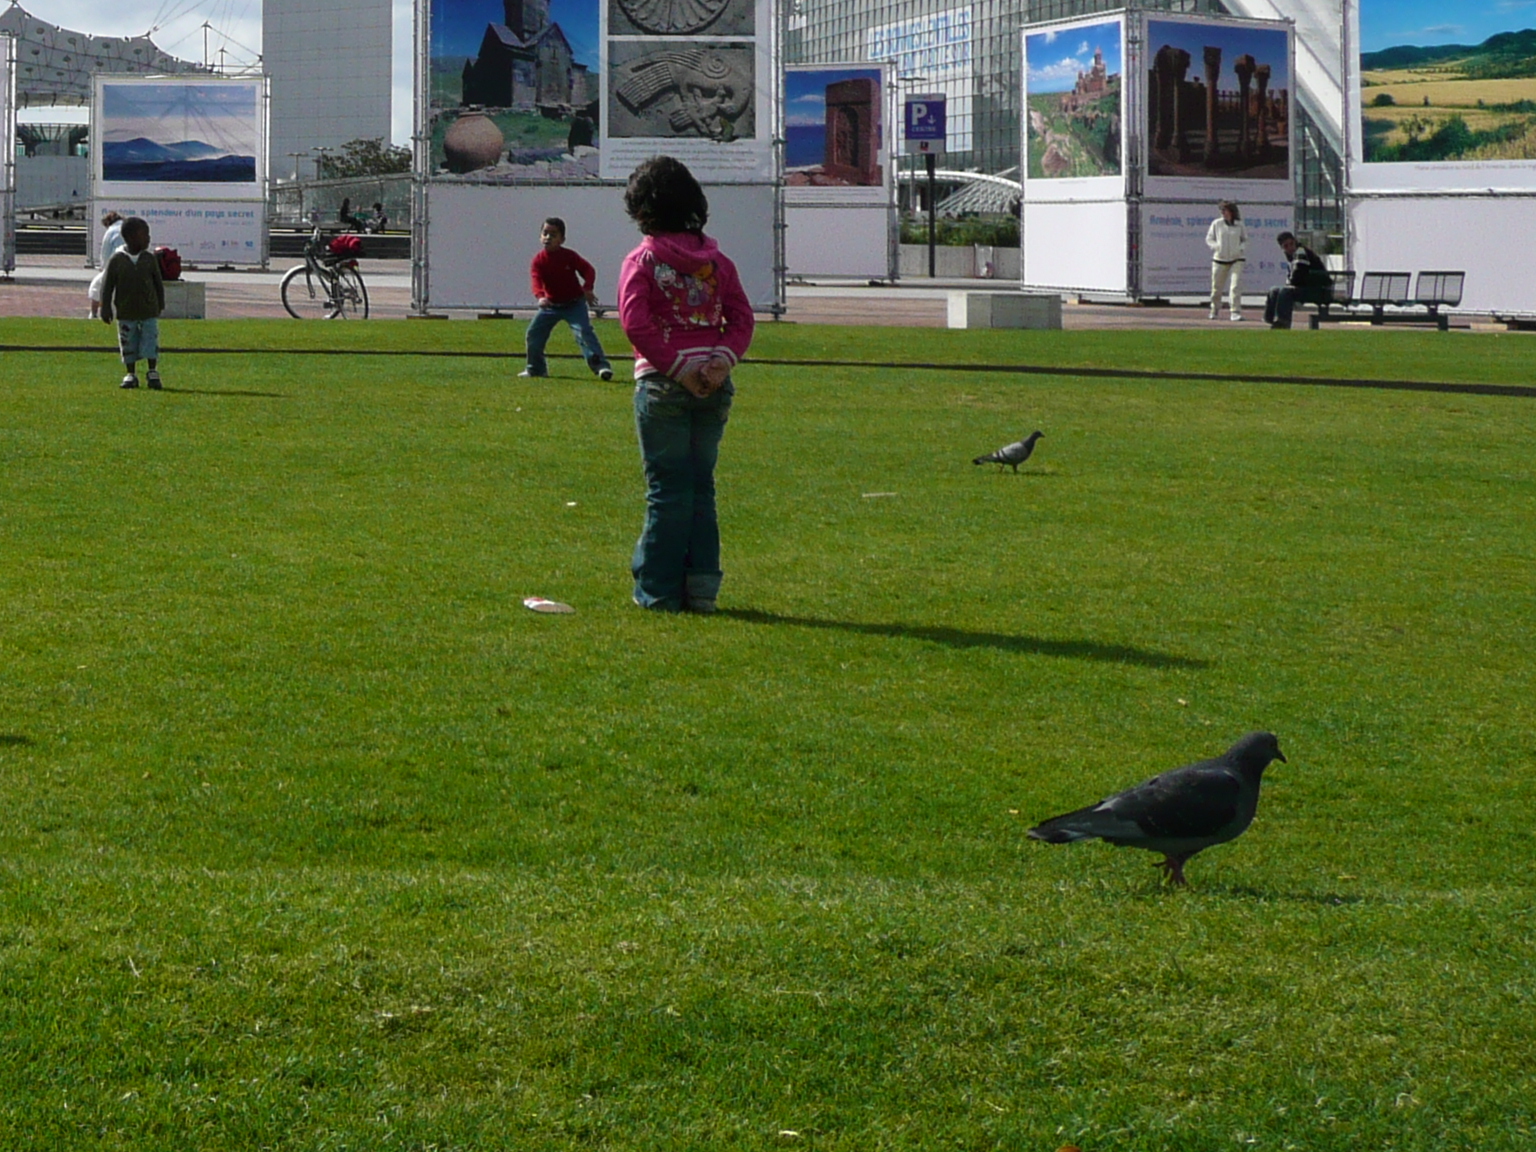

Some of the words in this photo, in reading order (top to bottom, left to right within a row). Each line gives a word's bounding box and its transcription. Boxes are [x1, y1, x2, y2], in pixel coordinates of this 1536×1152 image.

[911, 103, 928, 126] P
[141, 208, 183, 218] splendeur
[185, 209, 202, 218] d'un
[205, 209, 225, 219] pays
[227, 210, 254, 218] secret
[1264, 218, 1288, 227] secret
